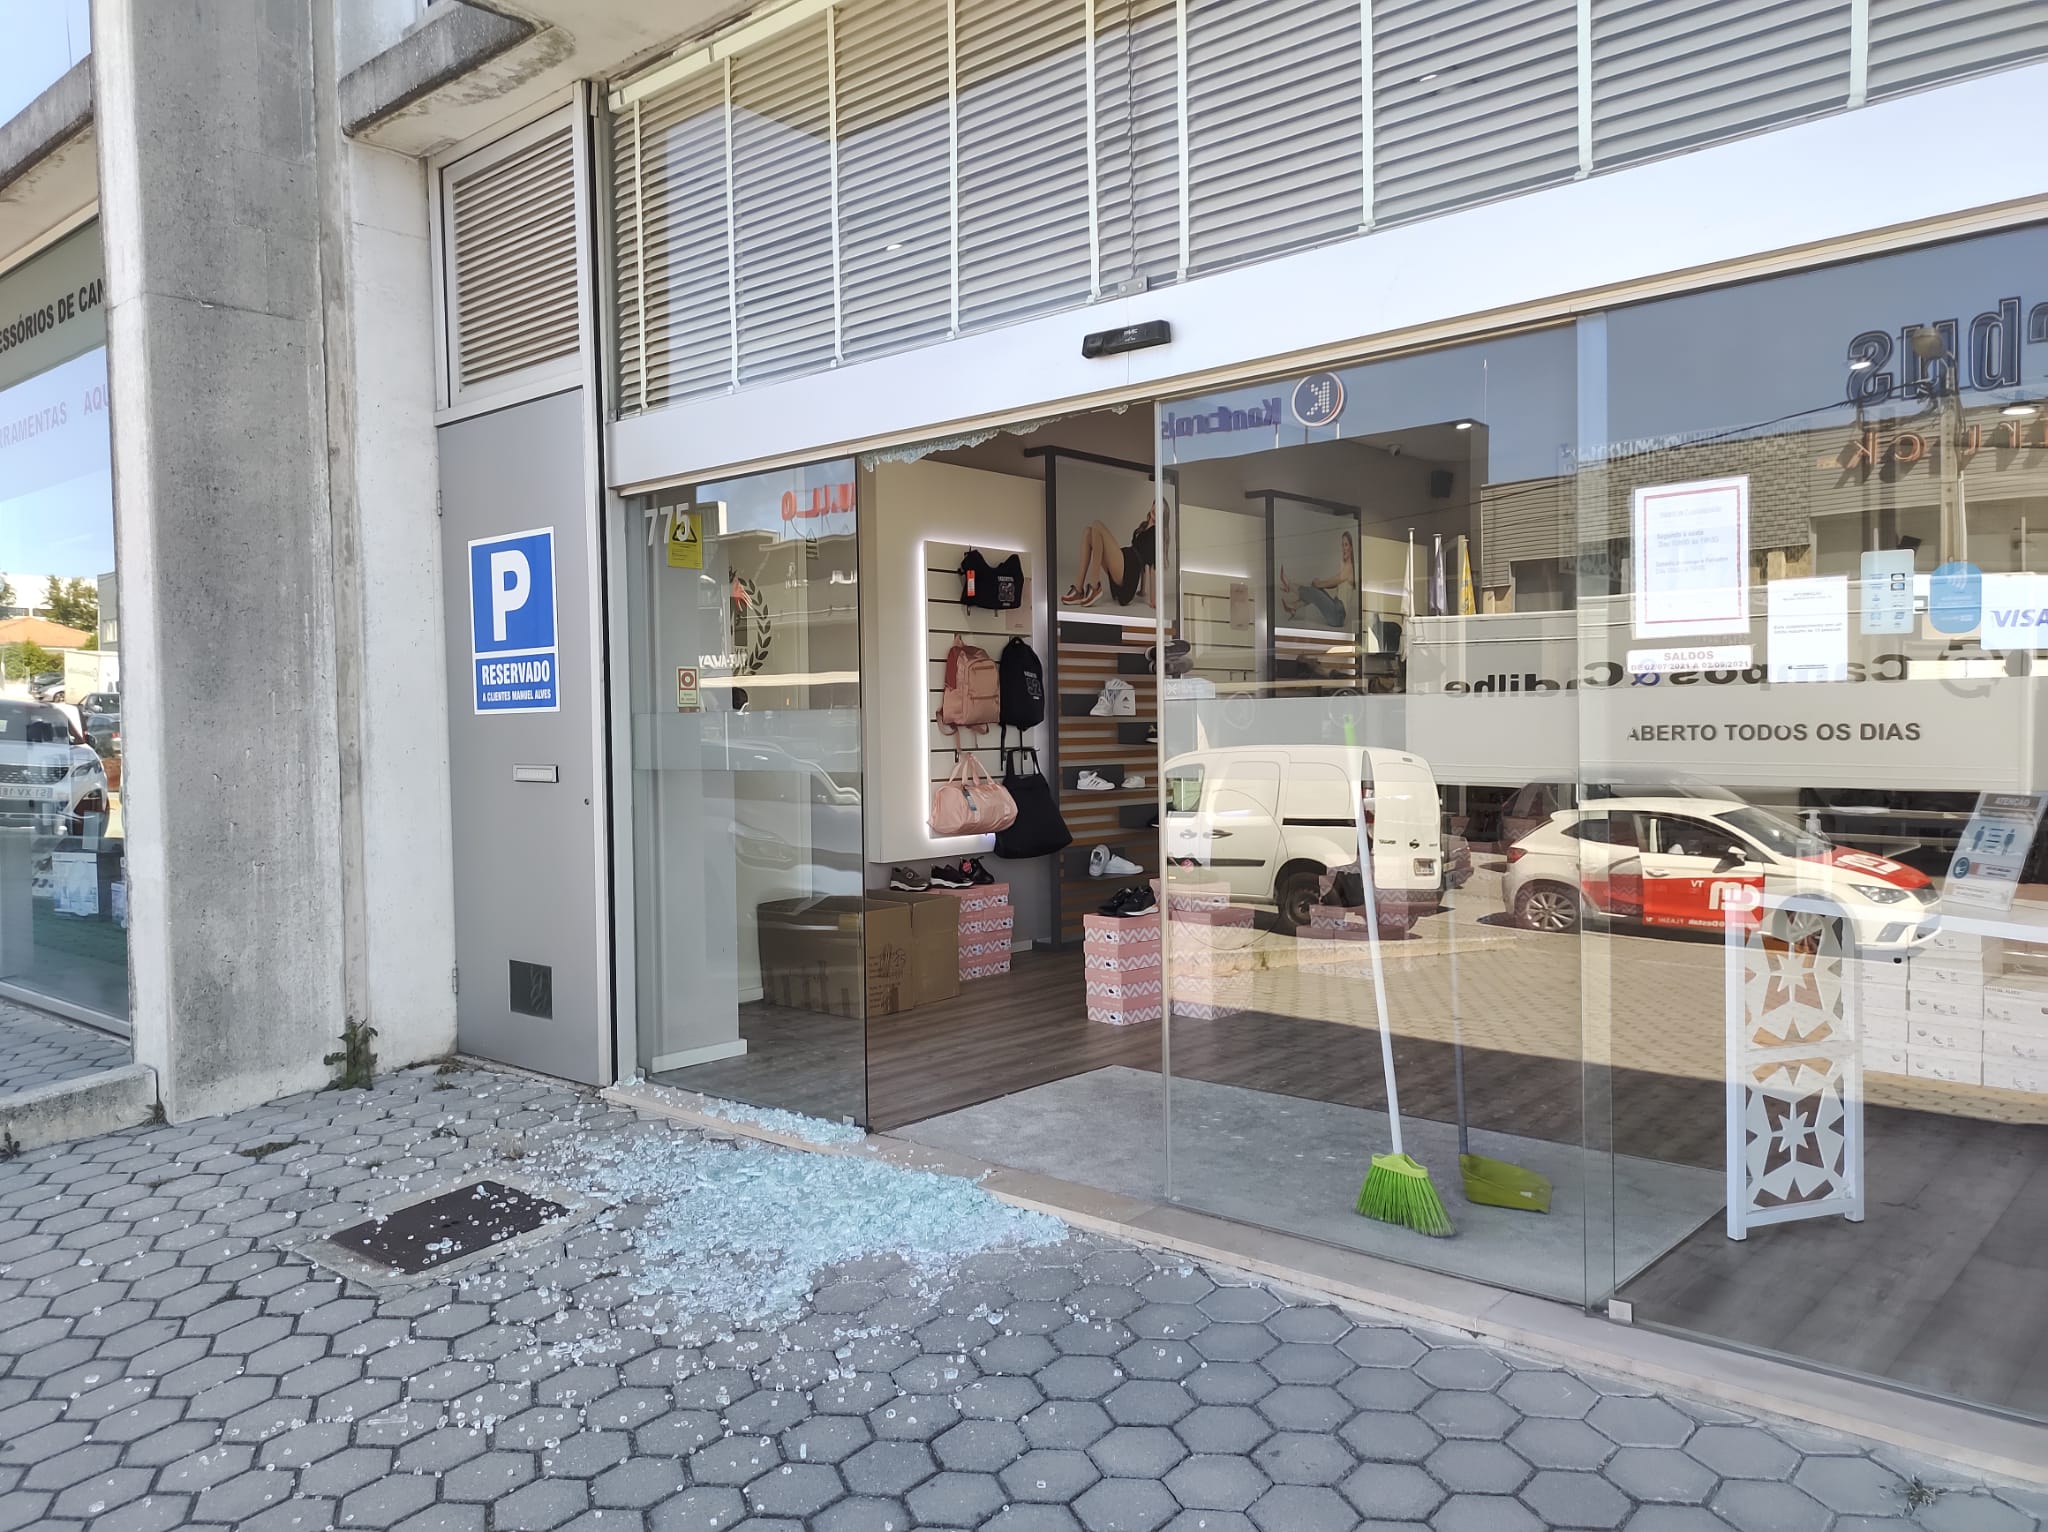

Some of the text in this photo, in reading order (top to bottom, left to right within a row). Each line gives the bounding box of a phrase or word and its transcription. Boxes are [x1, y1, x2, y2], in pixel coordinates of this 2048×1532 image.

[58, 293, 75, 325] DE
[644, 503, 691, 546] 775
[491, 550, 531, 641] P
[1991, 608, 2048, 628] VISA
[1663, 650, 1714, 661] SALDOS
[481, 660, 550, 685] RESERVADO
[535, 688, 551, 700] ALVES
[1628, 722, 1921, 742] ABERTO TODOS OS DIAS
